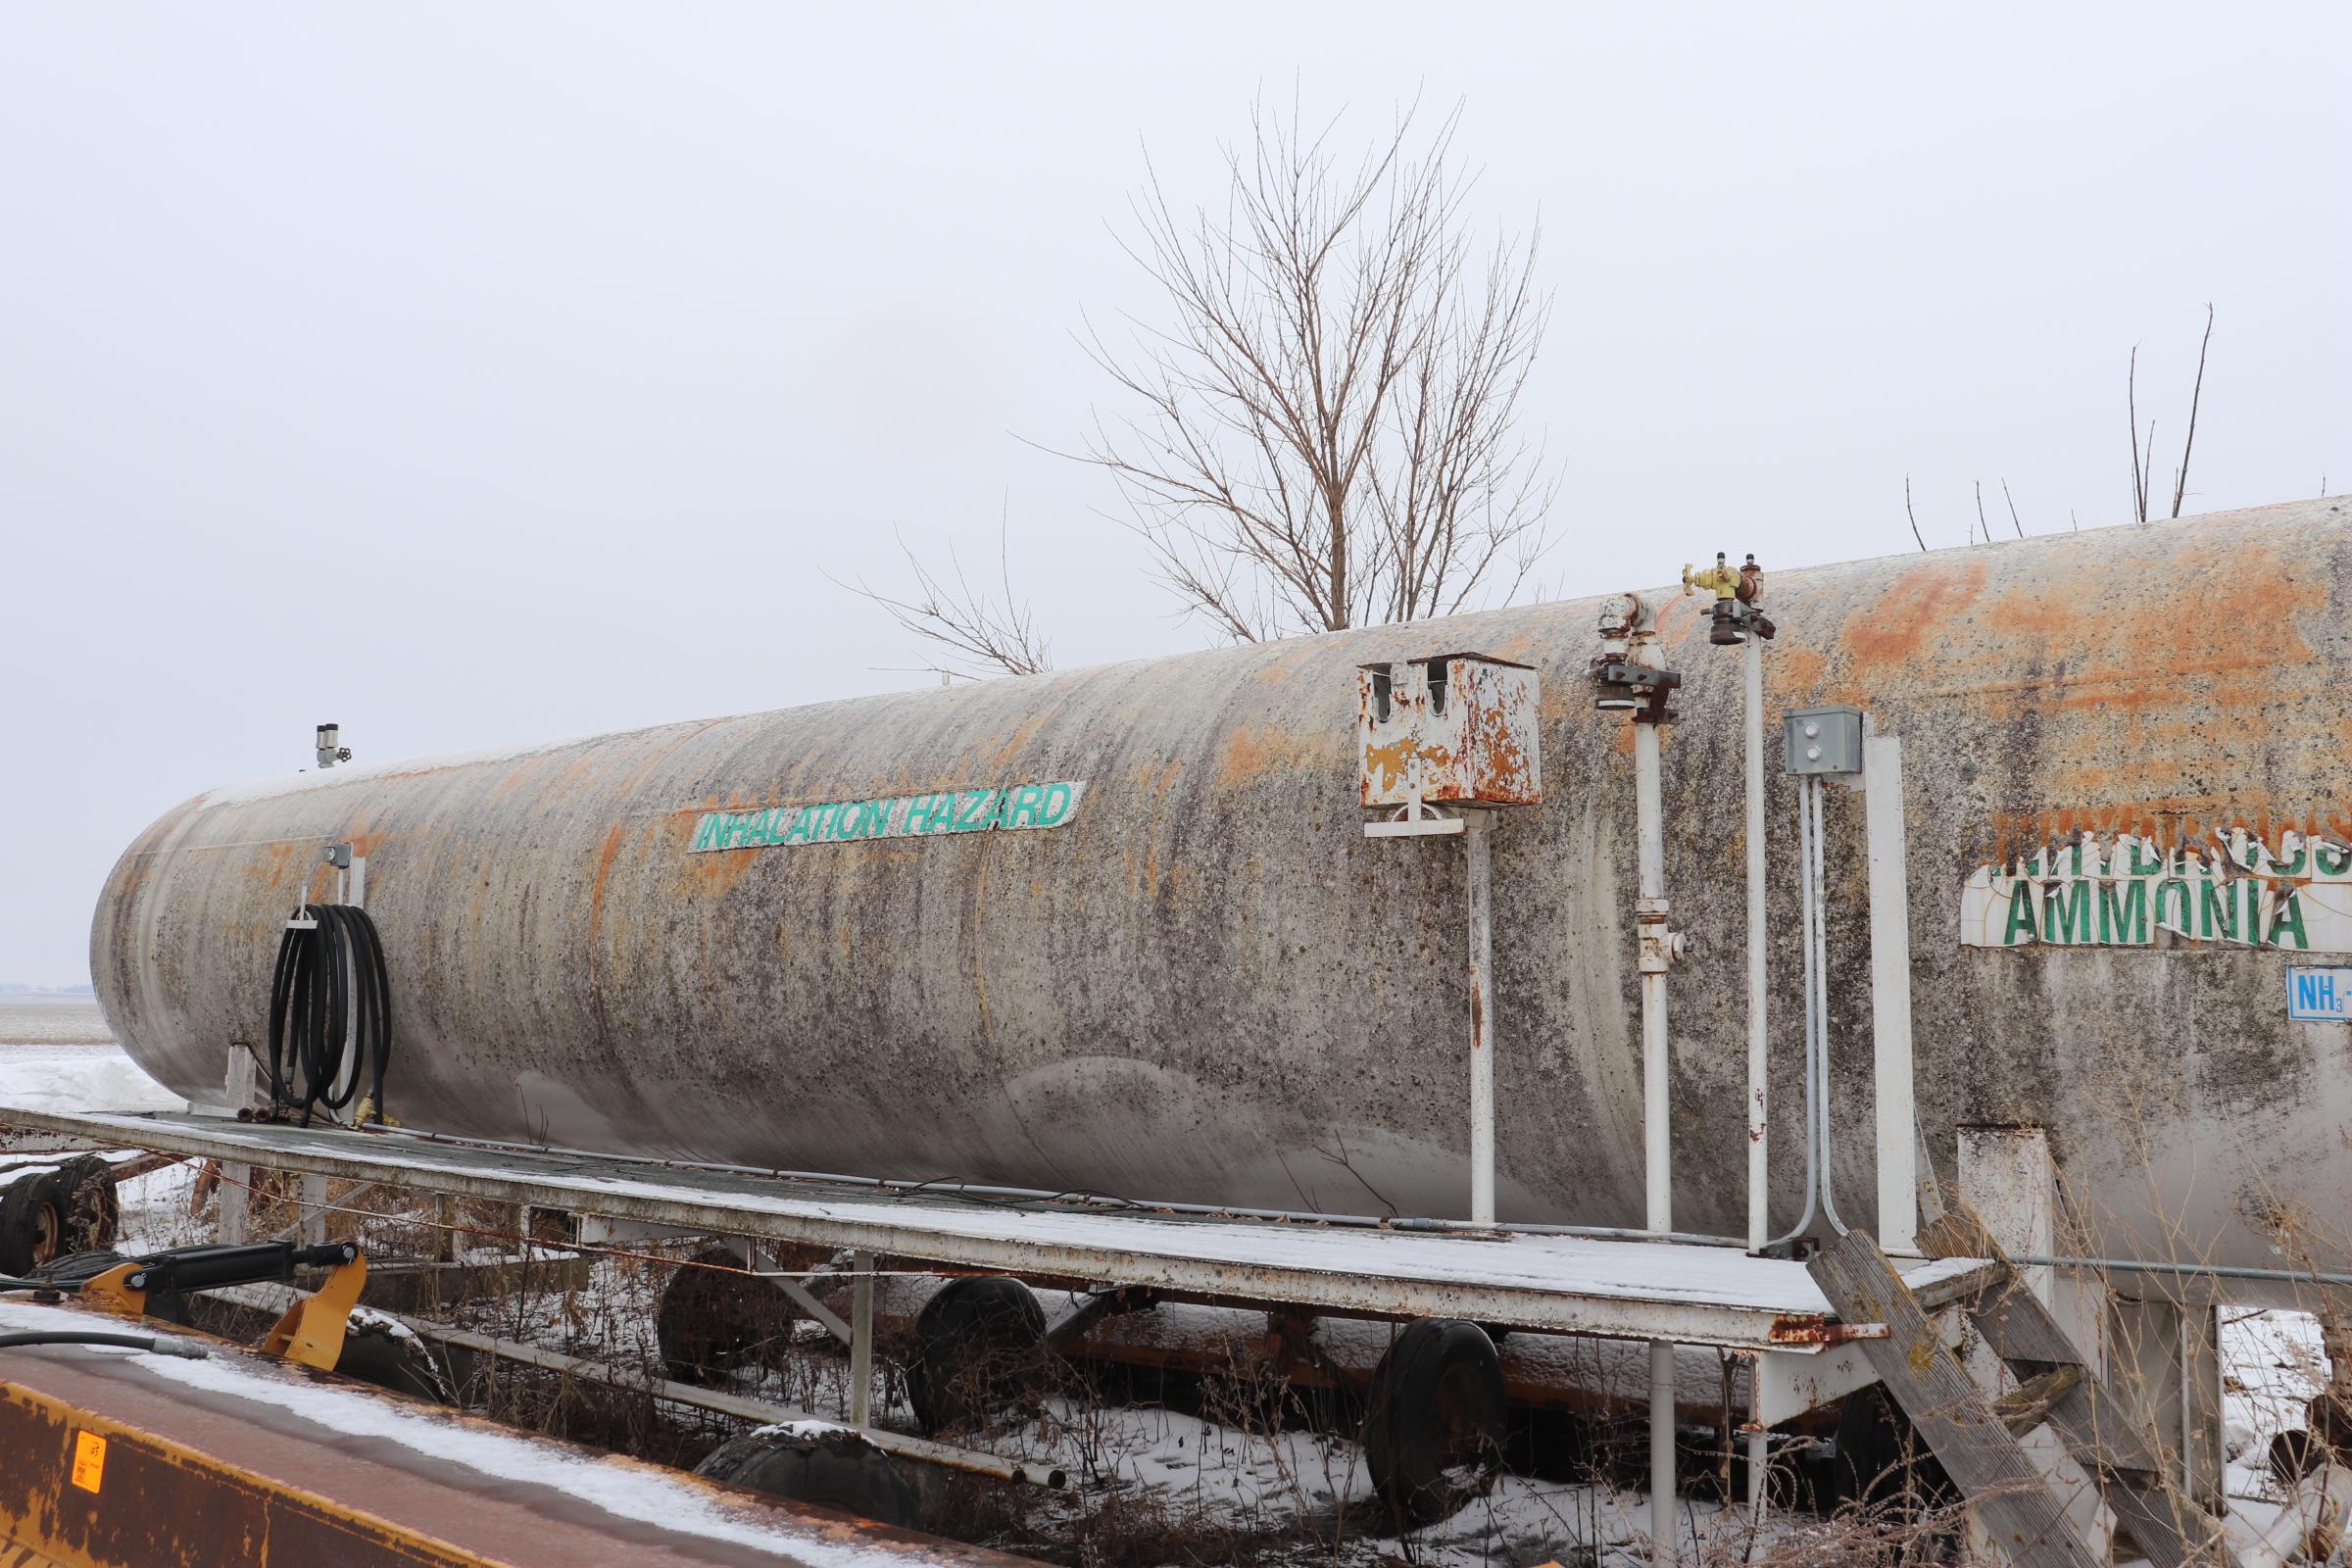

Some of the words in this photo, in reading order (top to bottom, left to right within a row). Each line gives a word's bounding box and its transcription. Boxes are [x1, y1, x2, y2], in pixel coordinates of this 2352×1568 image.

[696, 798, 895, 849] INHALATION
[903, 784, 1071, 833] HAZARD
[2004, 879, 2309, 949] AMMONIA
